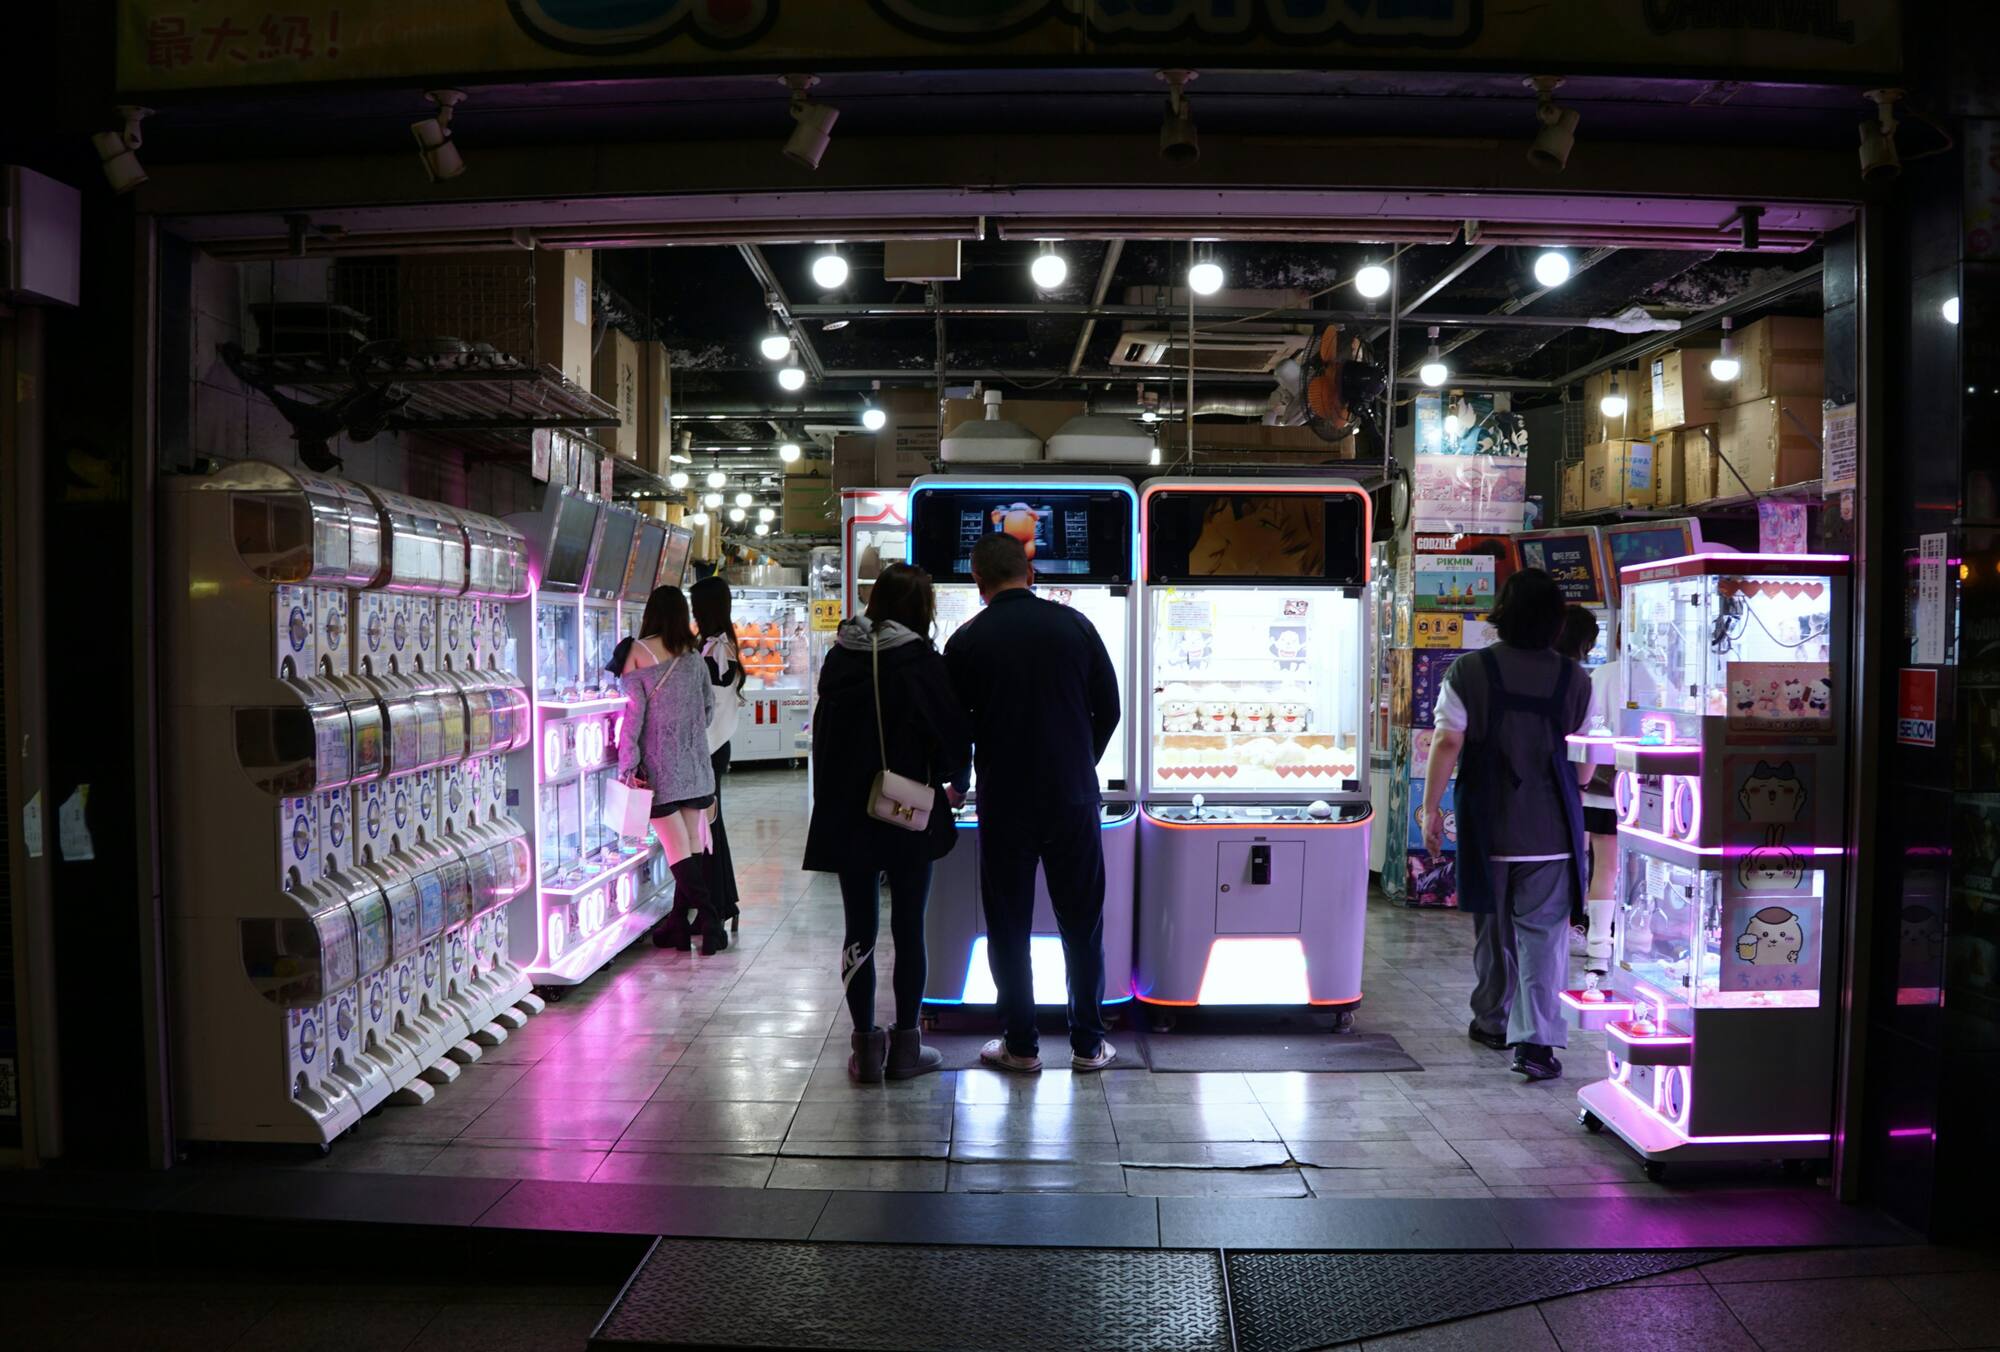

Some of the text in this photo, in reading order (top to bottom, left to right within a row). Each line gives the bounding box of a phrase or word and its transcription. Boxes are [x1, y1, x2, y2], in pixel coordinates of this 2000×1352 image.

[147, 10, 338, 69] 最大級!
[1436, 558, 1473, 566] PIKMIN
[1900, 720, 1934, 740] SECOM
[1738, 971, 1802, 987] ちいかわ
